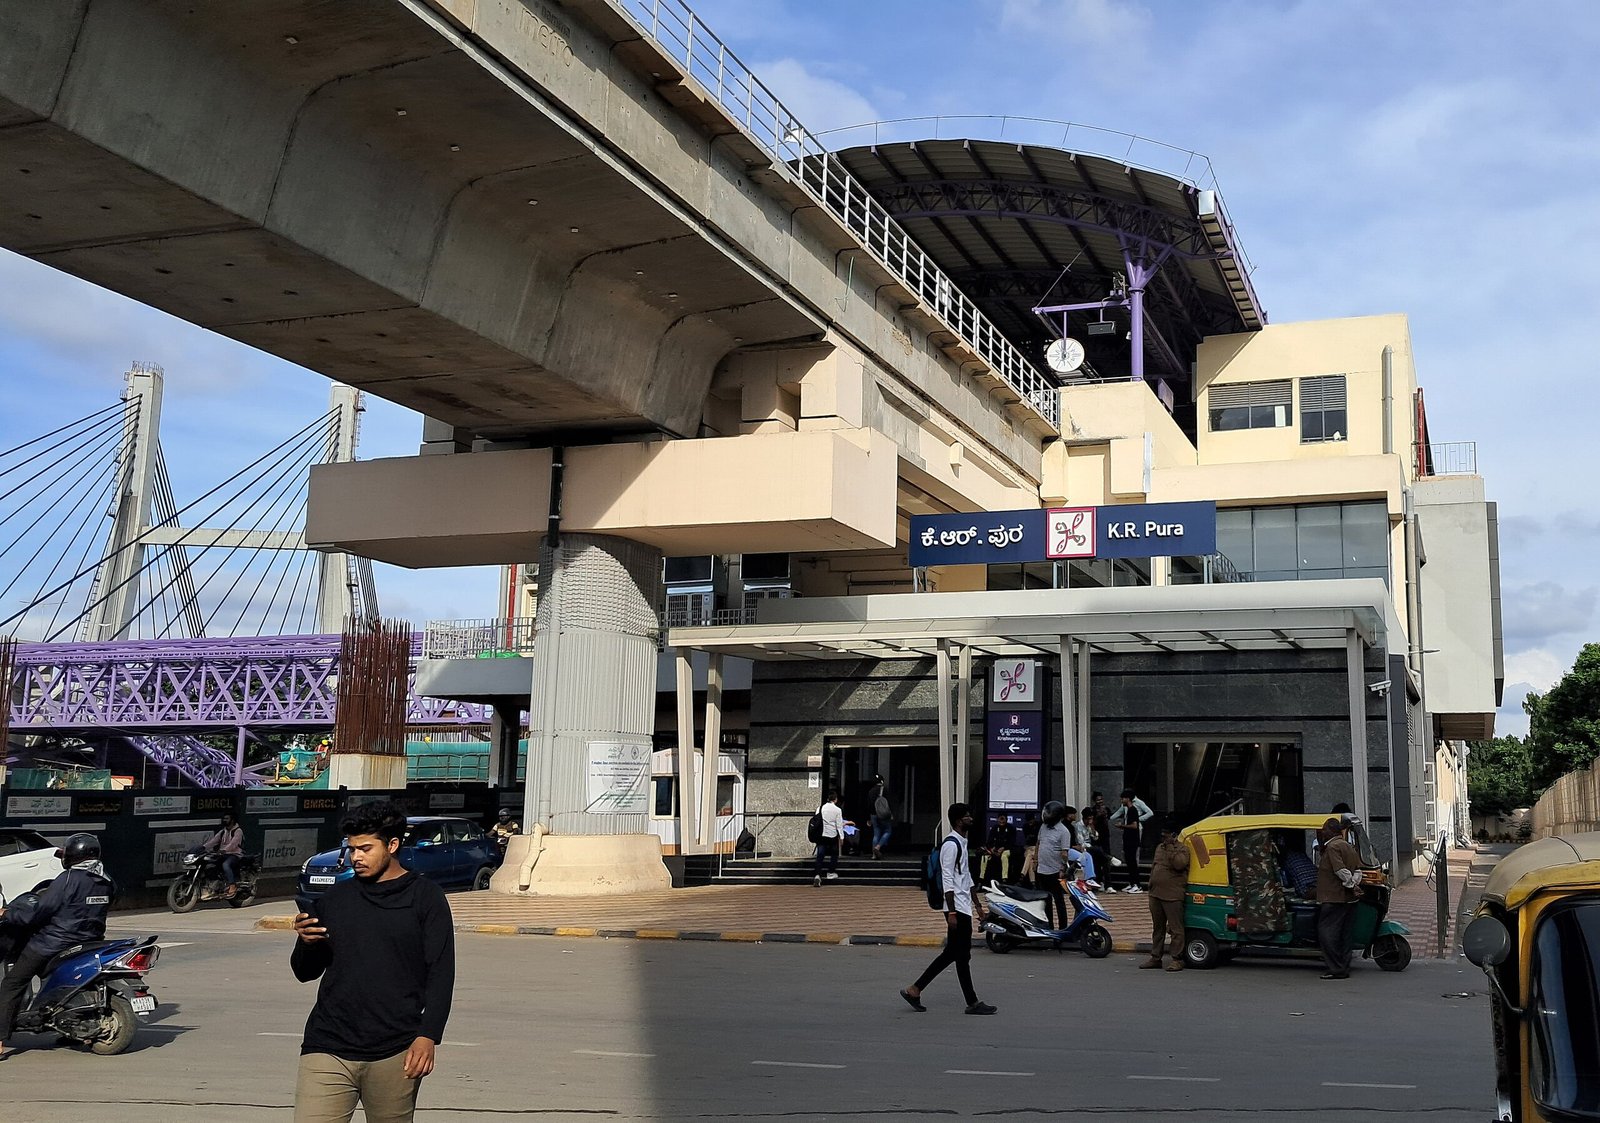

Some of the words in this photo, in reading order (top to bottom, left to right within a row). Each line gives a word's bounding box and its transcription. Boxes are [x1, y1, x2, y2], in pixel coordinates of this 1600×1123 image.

[920, 525, 983, 548] ಕೆ.ಆರ್.
[988, 523, 1024, 548] ಪುರ
[1107, 522, 1140, 539] K.R.
[1145, 520, 1184, 537] Pura
[153, 798, 174, 807] SNC
[197, 798, 233, 810] BMRCL
[303, 798, 337, 809] BMRCL
[264, 845, 296, 859] metro
